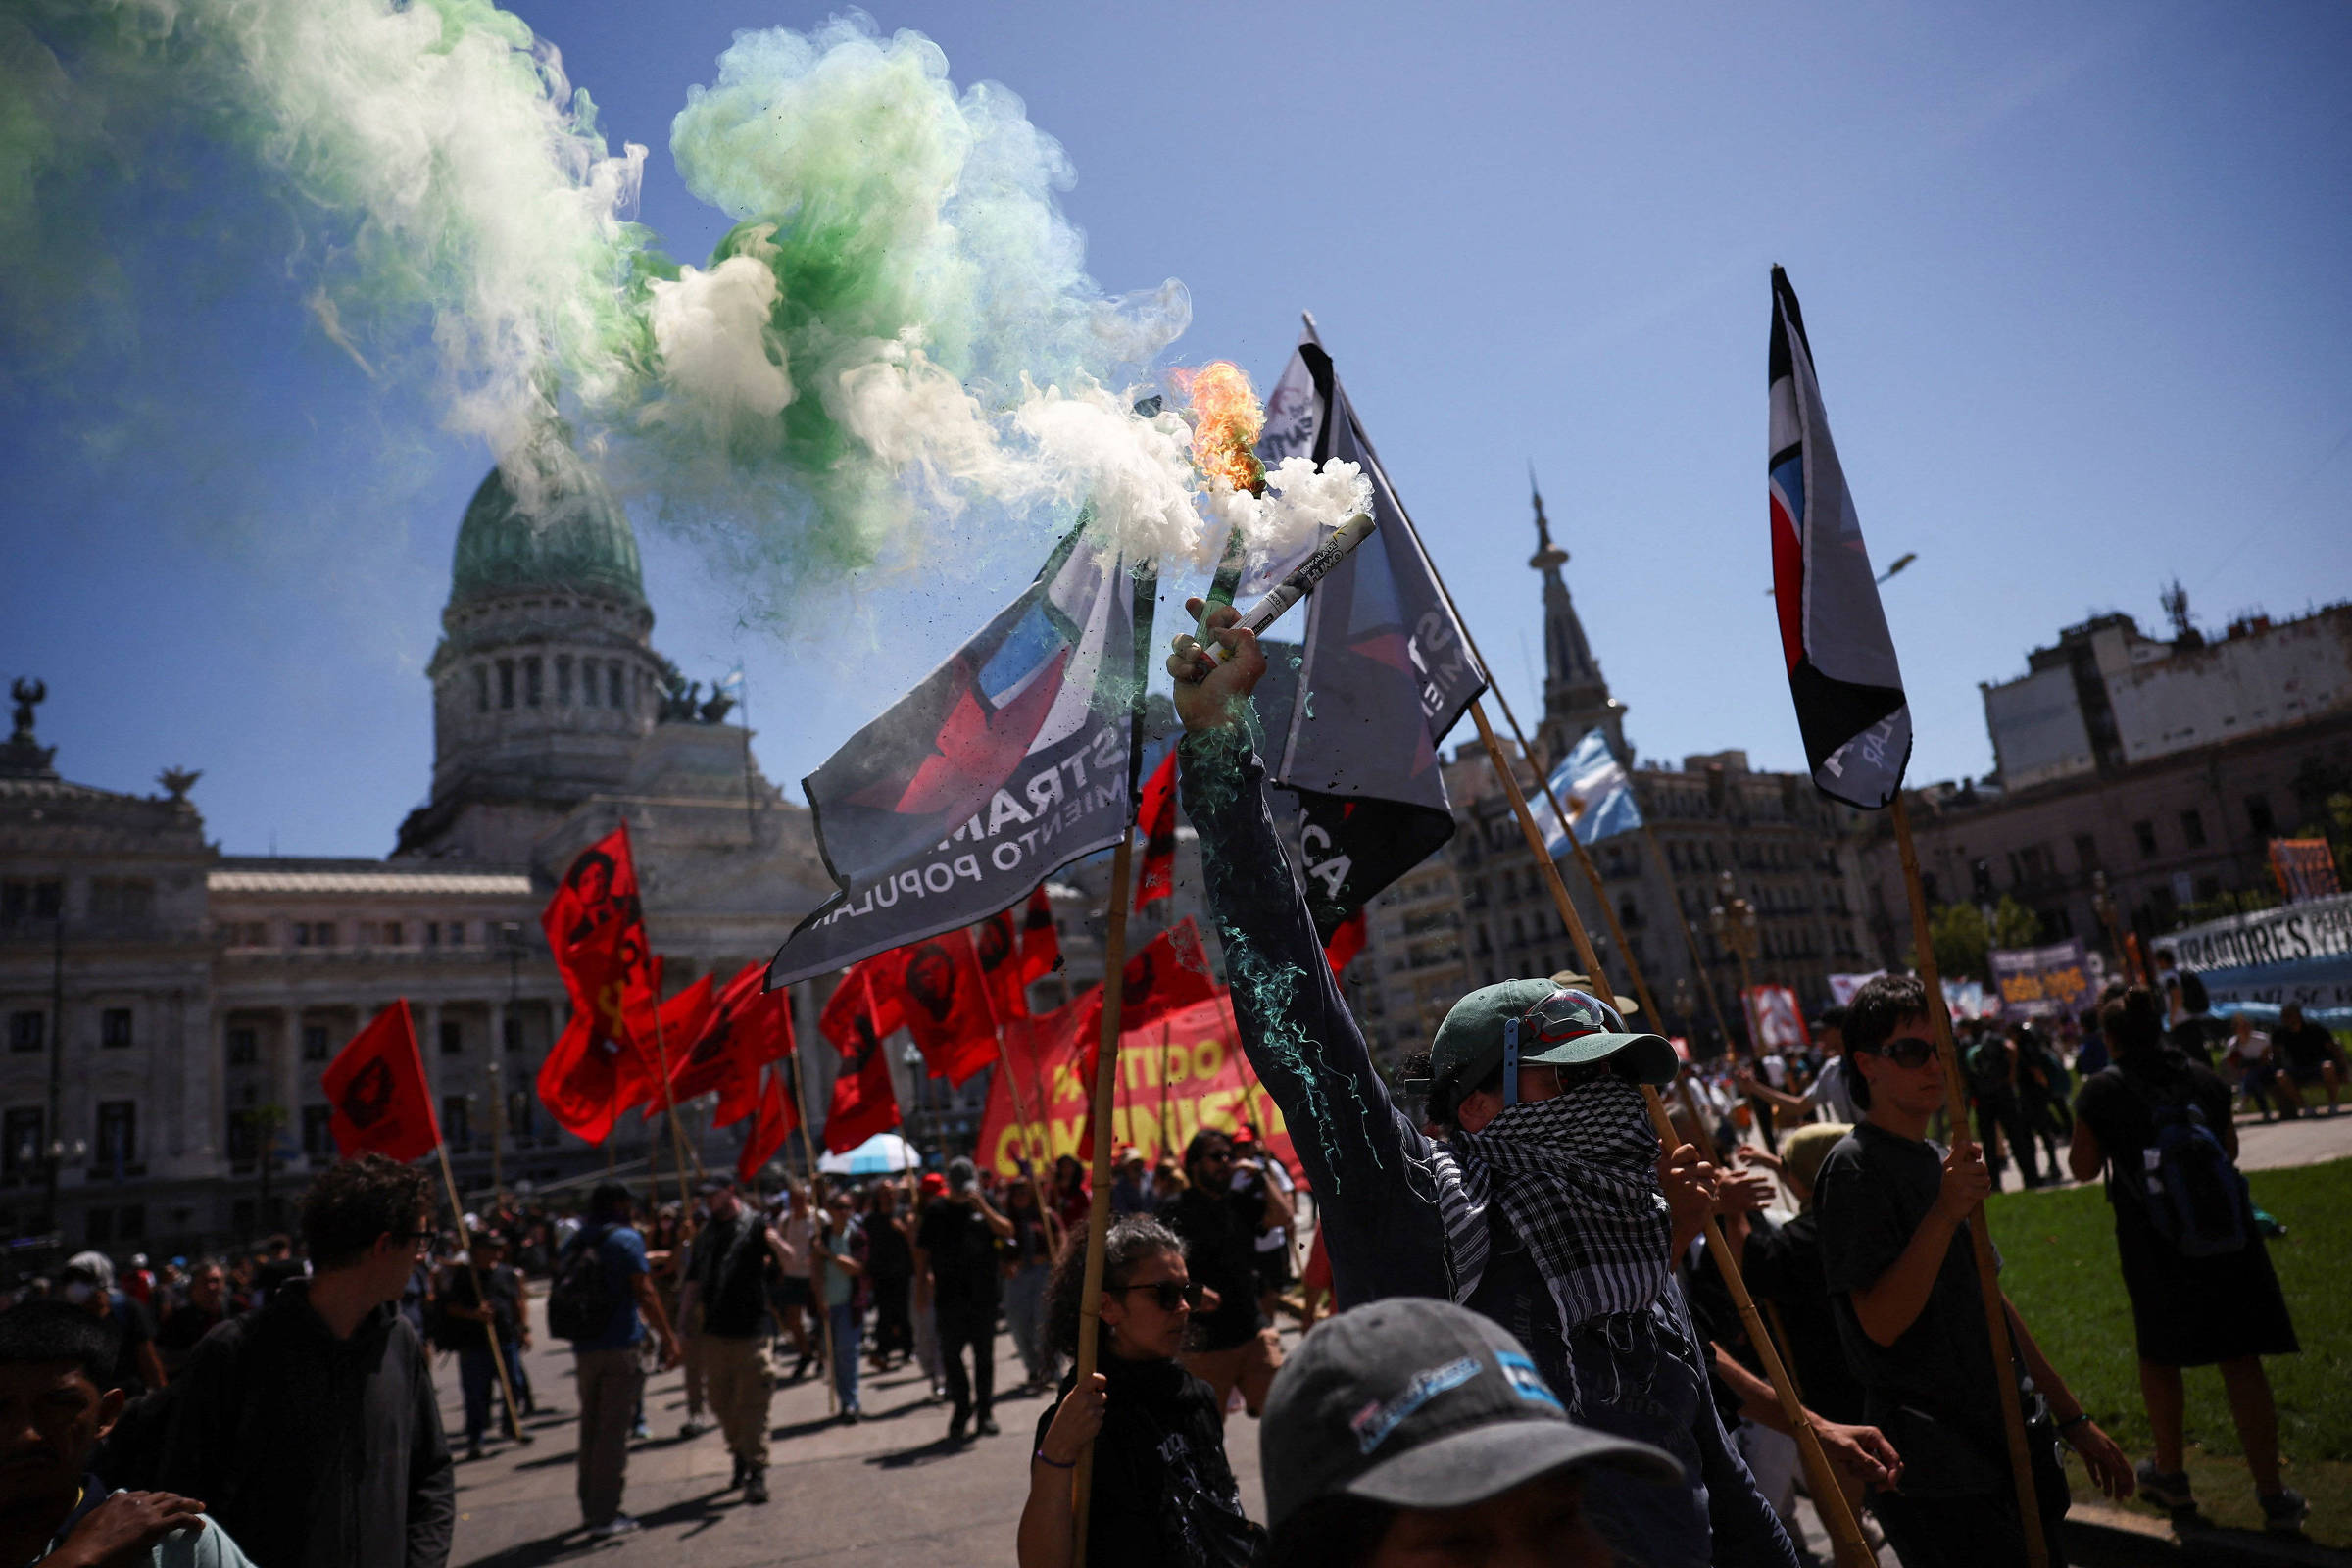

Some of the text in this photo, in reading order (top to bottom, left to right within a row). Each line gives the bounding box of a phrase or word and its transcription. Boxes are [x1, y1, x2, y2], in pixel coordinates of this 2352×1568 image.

[1299, 550, 1329, 575] BENGALA
[1306, 549, 1343, 585] HUMO
[1299, 808, 1352, 901] CA
